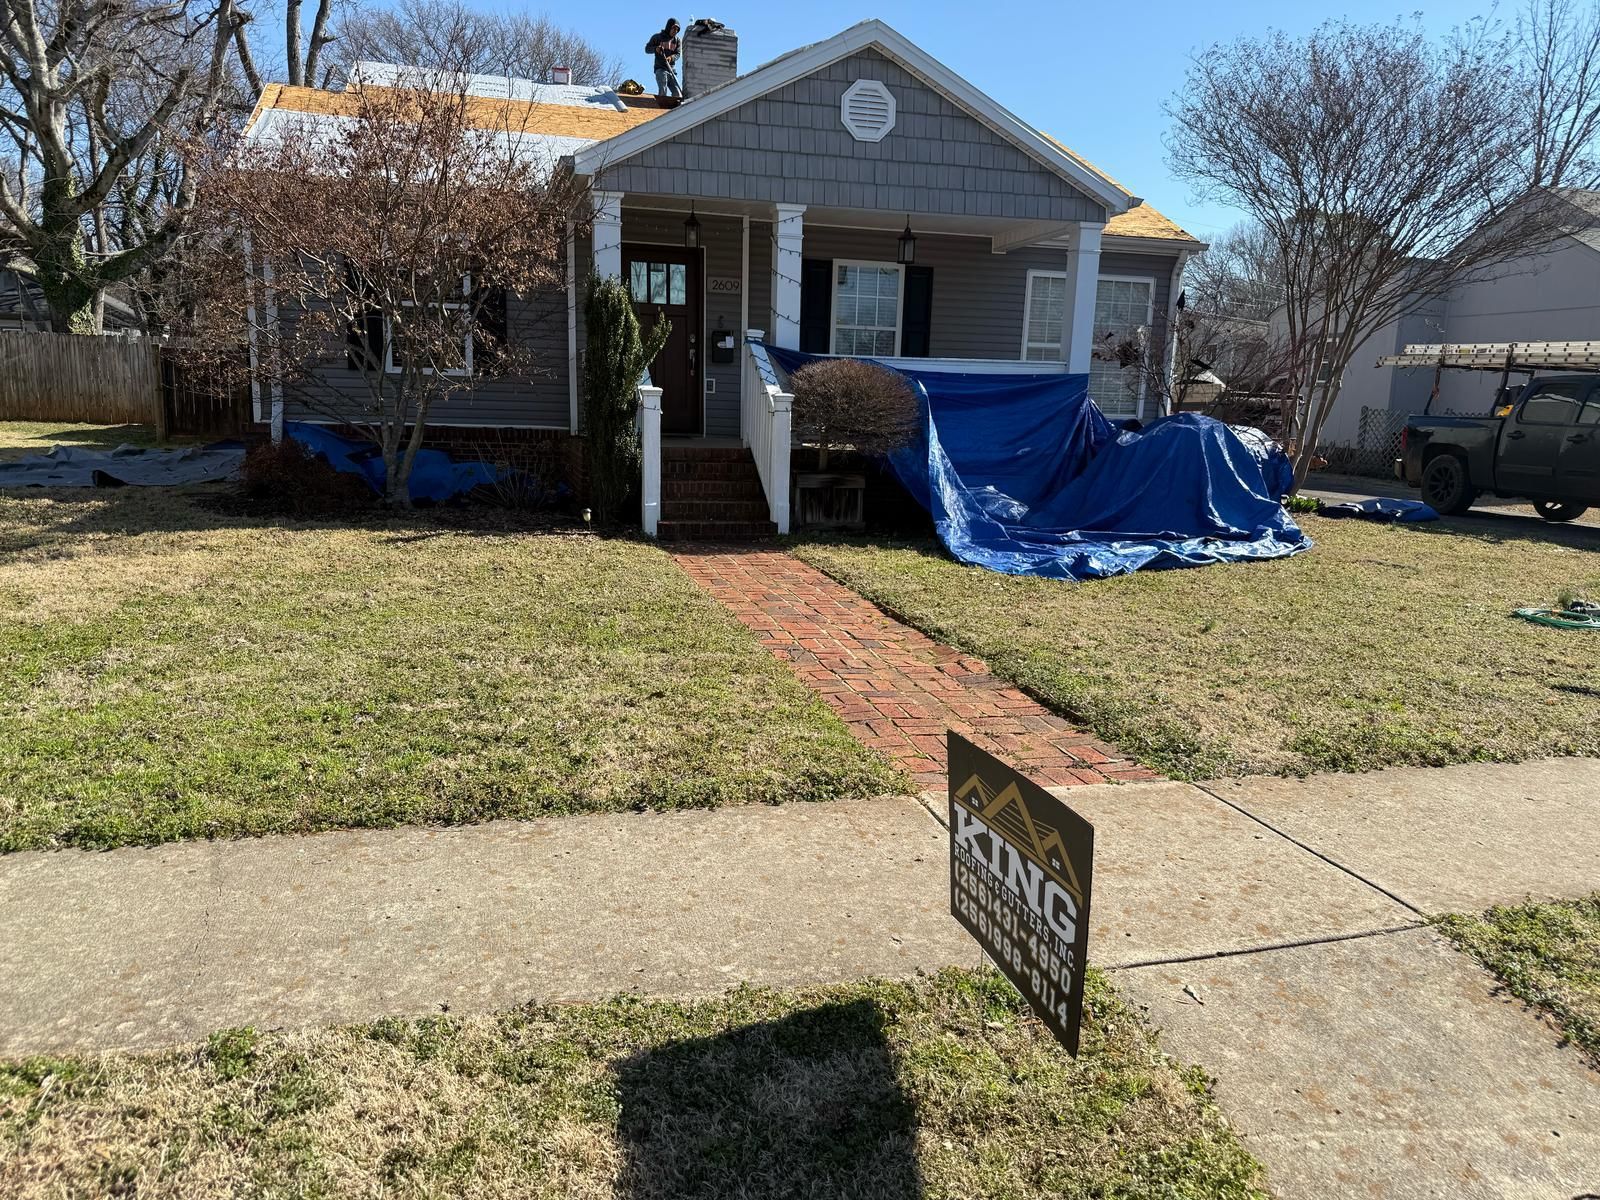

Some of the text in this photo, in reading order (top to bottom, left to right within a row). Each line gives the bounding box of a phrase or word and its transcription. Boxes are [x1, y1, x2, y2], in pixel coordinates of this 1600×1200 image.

[711, 280, 740, 291] 2609
[954, 801, 1077, 944] KING
[954, 841, 993, 888] ROOFING
[1053, 935, 1076, 972] INC.
[954, 859, 1072, 996] (256)431-4950
[954, 885, 1068, 1032] (256)998-8114
